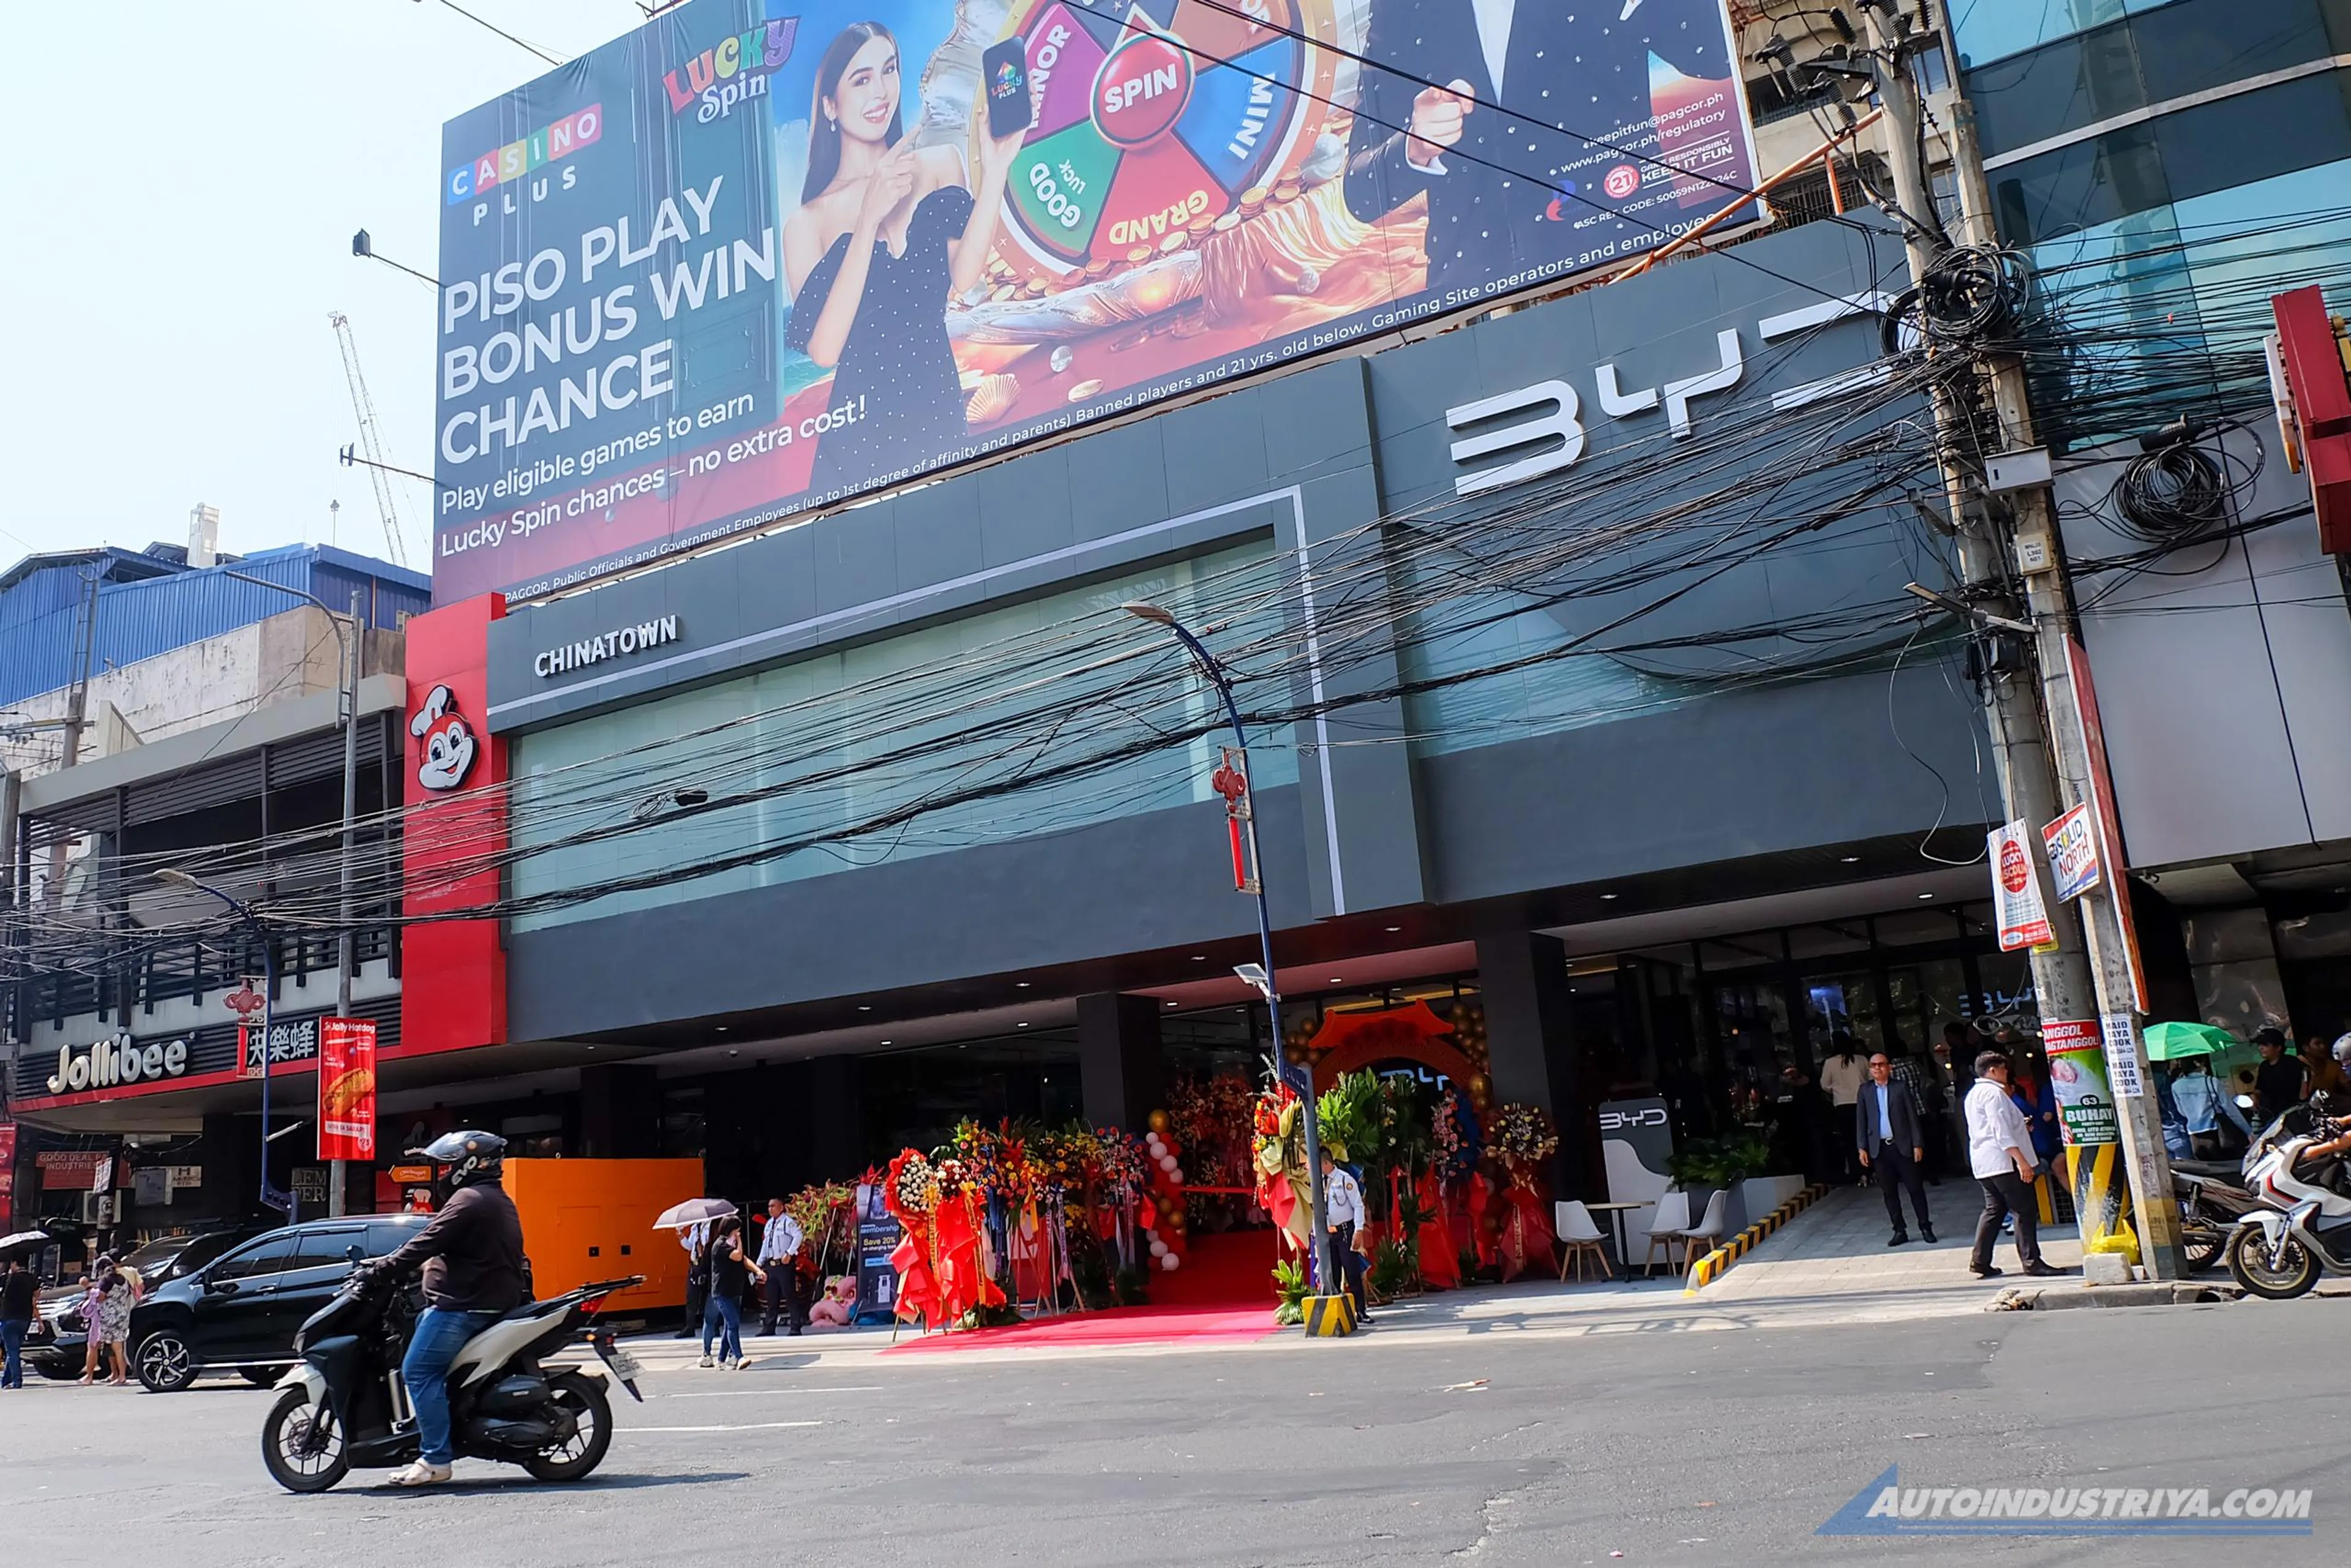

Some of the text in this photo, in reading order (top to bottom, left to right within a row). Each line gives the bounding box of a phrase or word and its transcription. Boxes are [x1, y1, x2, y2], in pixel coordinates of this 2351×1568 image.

[662, 16, 801, 114] LUCKY
[991, 75, 1022, 96] LUCKY
[1104, 62, 1178, 114] SPIN
[697, 72, 767, 123] Spin
[999, 87, 1016, 99] PLUS
[1228, 73, 1275, 160] MINI
[1589, 92, 1723, 147] keepitfun@pagcor.ph
[451, 110, 599, 196] CASINO
[1561, 109, 1726, 173] www.pagcor.ph/regulatory
[1668, 137, 1730, 163] RESPONSIBLY
[1684, 156, 1698, 169] IT
[1702, 144, 1733, 163] FUN
[474, 166, 576, 226] PLUS
[1029, 163, 1081, 228] GOOD
[1057, 159, 1087, 194] LUCK
[1612, 174, 1630, 190] 21
[1109, 190, 1209, 245] GRAND
[1622, 199, 1655, 214] CODE:
[444, 175, 724, 334] PISO PLAY
[444, 228, 776, 400] BONUS WIN
[441, 339, 673, 464] CHANCE
[1445, 290, 1921, 497] BYD
[504, 580, 550, 604] PAGCOR,
[553, 569, 586, 588] Public
[589, 553, 632, 575] Officials
[636, 546, 656, 563] and
[660, 524, 731, 553] Government
[735, 503, 799, 531] Employees
[803, 494, 823, 511] (up
[827, 487, 839, 500] to
[843, 482, 859, 497] 1st
[864, 467, 909, 490] degree
[913, 459, 927, 474] of
[929, 444, 978, 468] affinity
[981, 433, 1008, 452] and
[1013, 415, 1071, 446] parents)
[1076, 394, 1133, 422] Banned
[1138, 375, 1192, 405] players
[1196, 363, 1226, 384] and
[1231, 357, 1246, 373] 21
[1250, 350, 1278, 371] yrs.
[1283, 336, 1308, 357] old
[1313, 321, 1367, 348] below.
[1372, 298, 1441, 328] Gaming
[1445, 284, 1479, 306] Site
[1485, 254, 1574, 294] operators
[1580, 240, 1614, 264] and
[441, 391, 754, 514] Play eligible games to earn
[441, 520, 507, 557] Lucky
[511, 502, 560, 537] Spin
[567, 470, 664, 517] chances
[689, 449, 722, 477] no
[727, 424, 793, 463] extra
[800, 395, 867, 439] cost!
[534, 615, 678, 678] CHINATOWN
[2056, 819, 2082, 856] SOLID
[2058, 831, 2090, 879] NORTH
[348, 1023, 375, 1034] Hotdog
[47, 1033, 187, 1094] Jollibee
[1599, 1108, 1667, 1130] BYD
[2065, 1108, 2112, 1122] BUHAY
[2082, 1097, 2098, 1106] 63
[39, 1153, 67, 1162] GOOD
[69, 1153, 92, 1161] DEAL
[451, 1155, 478, 1185] EVO
